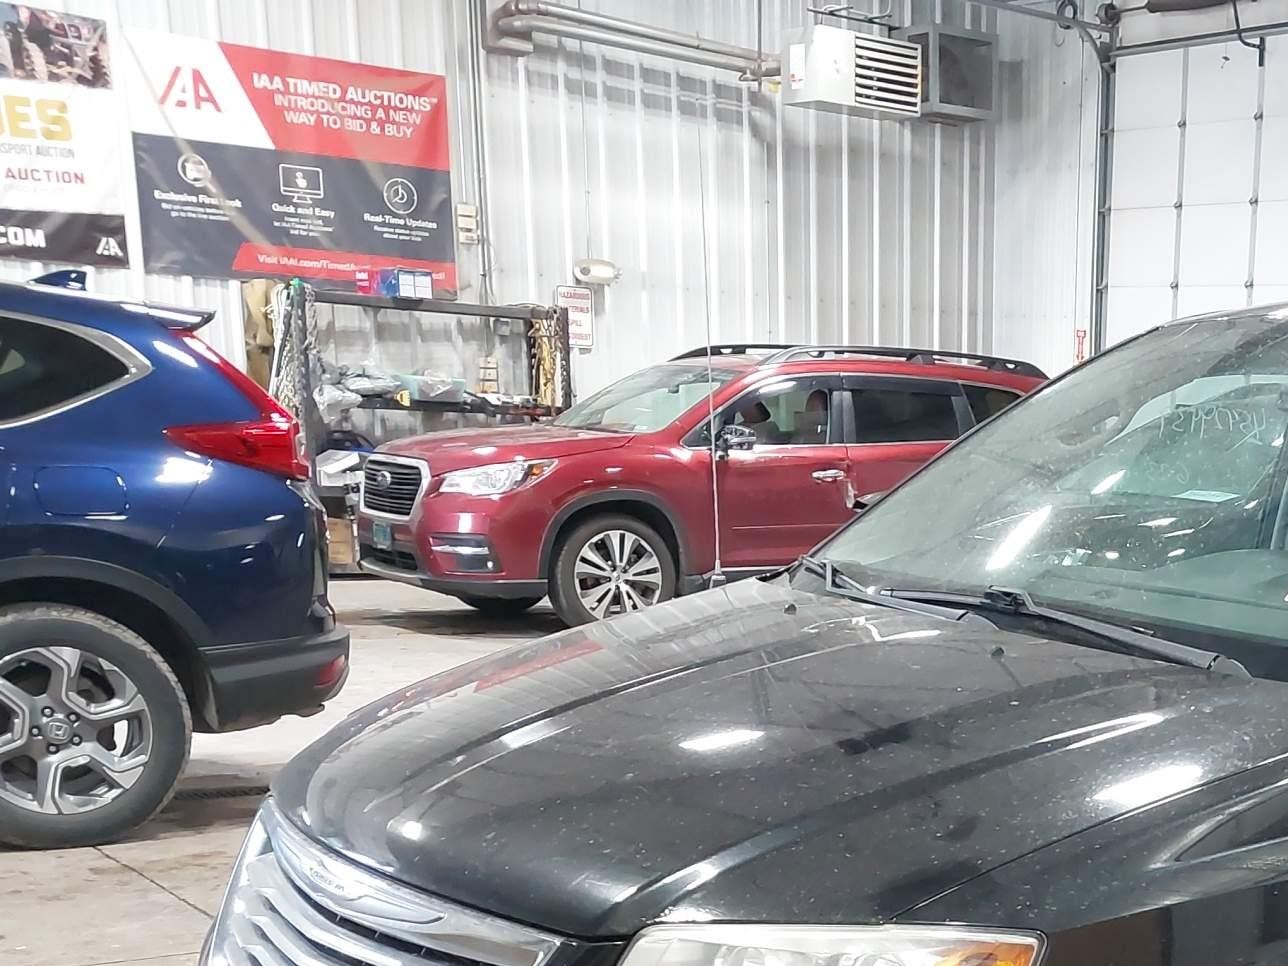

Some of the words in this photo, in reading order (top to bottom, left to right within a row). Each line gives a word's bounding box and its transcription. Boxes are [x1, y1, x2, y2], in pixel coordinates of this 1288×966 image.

[253, 73, 285, 91] IAA
[286, 77, 341, 99] TIMED
[274, 93, 371, 118] INTRODUCING
[375, 109, 386, 120] A
[389, 110, 421, 125] NEW
[0, 95, 72, 141] ES
[284, 110, 317, 126] WAY
[320, 114, 340, 129] TO
[344, 119, 366, 132] BID
[370, 122, 381, 135] &
[384, 123, 413, 138] BUY
[0, 142, 32, 156] SPORT
[5, 167, 85, 184] AUCTION
[272, 203, 296, 214] Quick
[297, 206, 313, 215] and
[315, 207, 335, 219] Easy
[364, 213, 405, 225] Real-Time
[406, 217, 437, 229] Updates
[257, 254, 278, 265] Visit
